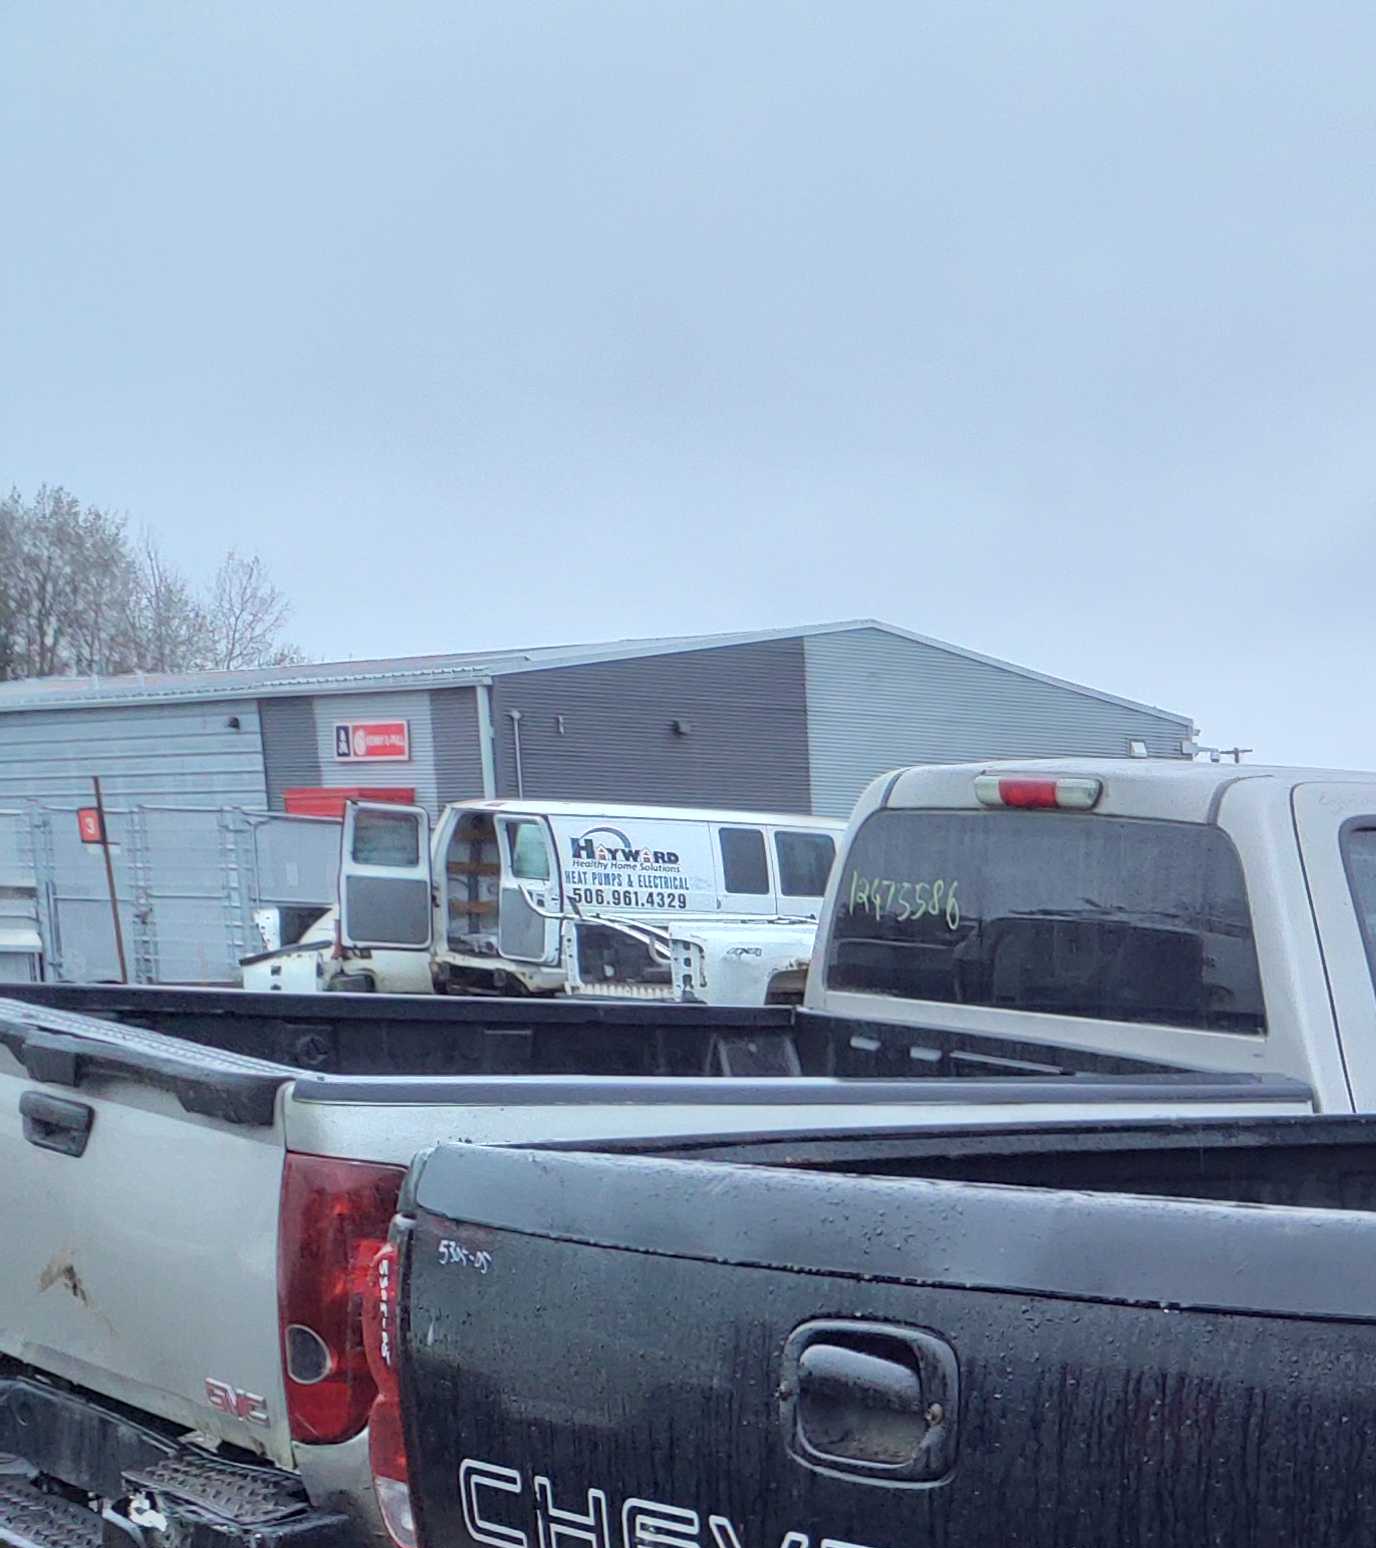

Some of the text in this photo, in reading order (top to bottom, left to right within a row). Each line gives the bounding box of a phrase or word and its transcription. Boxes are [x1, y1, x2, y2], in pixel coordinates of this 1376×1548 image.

[570, 838, 679, 864] HAYWARD
[573, 860, 680, 873] Healthy Home Solutions
[565, 870, 689, 890] HEAT PUMPS & ELECTRICAL
[572, 888, 687, 909] 506.961.4329
